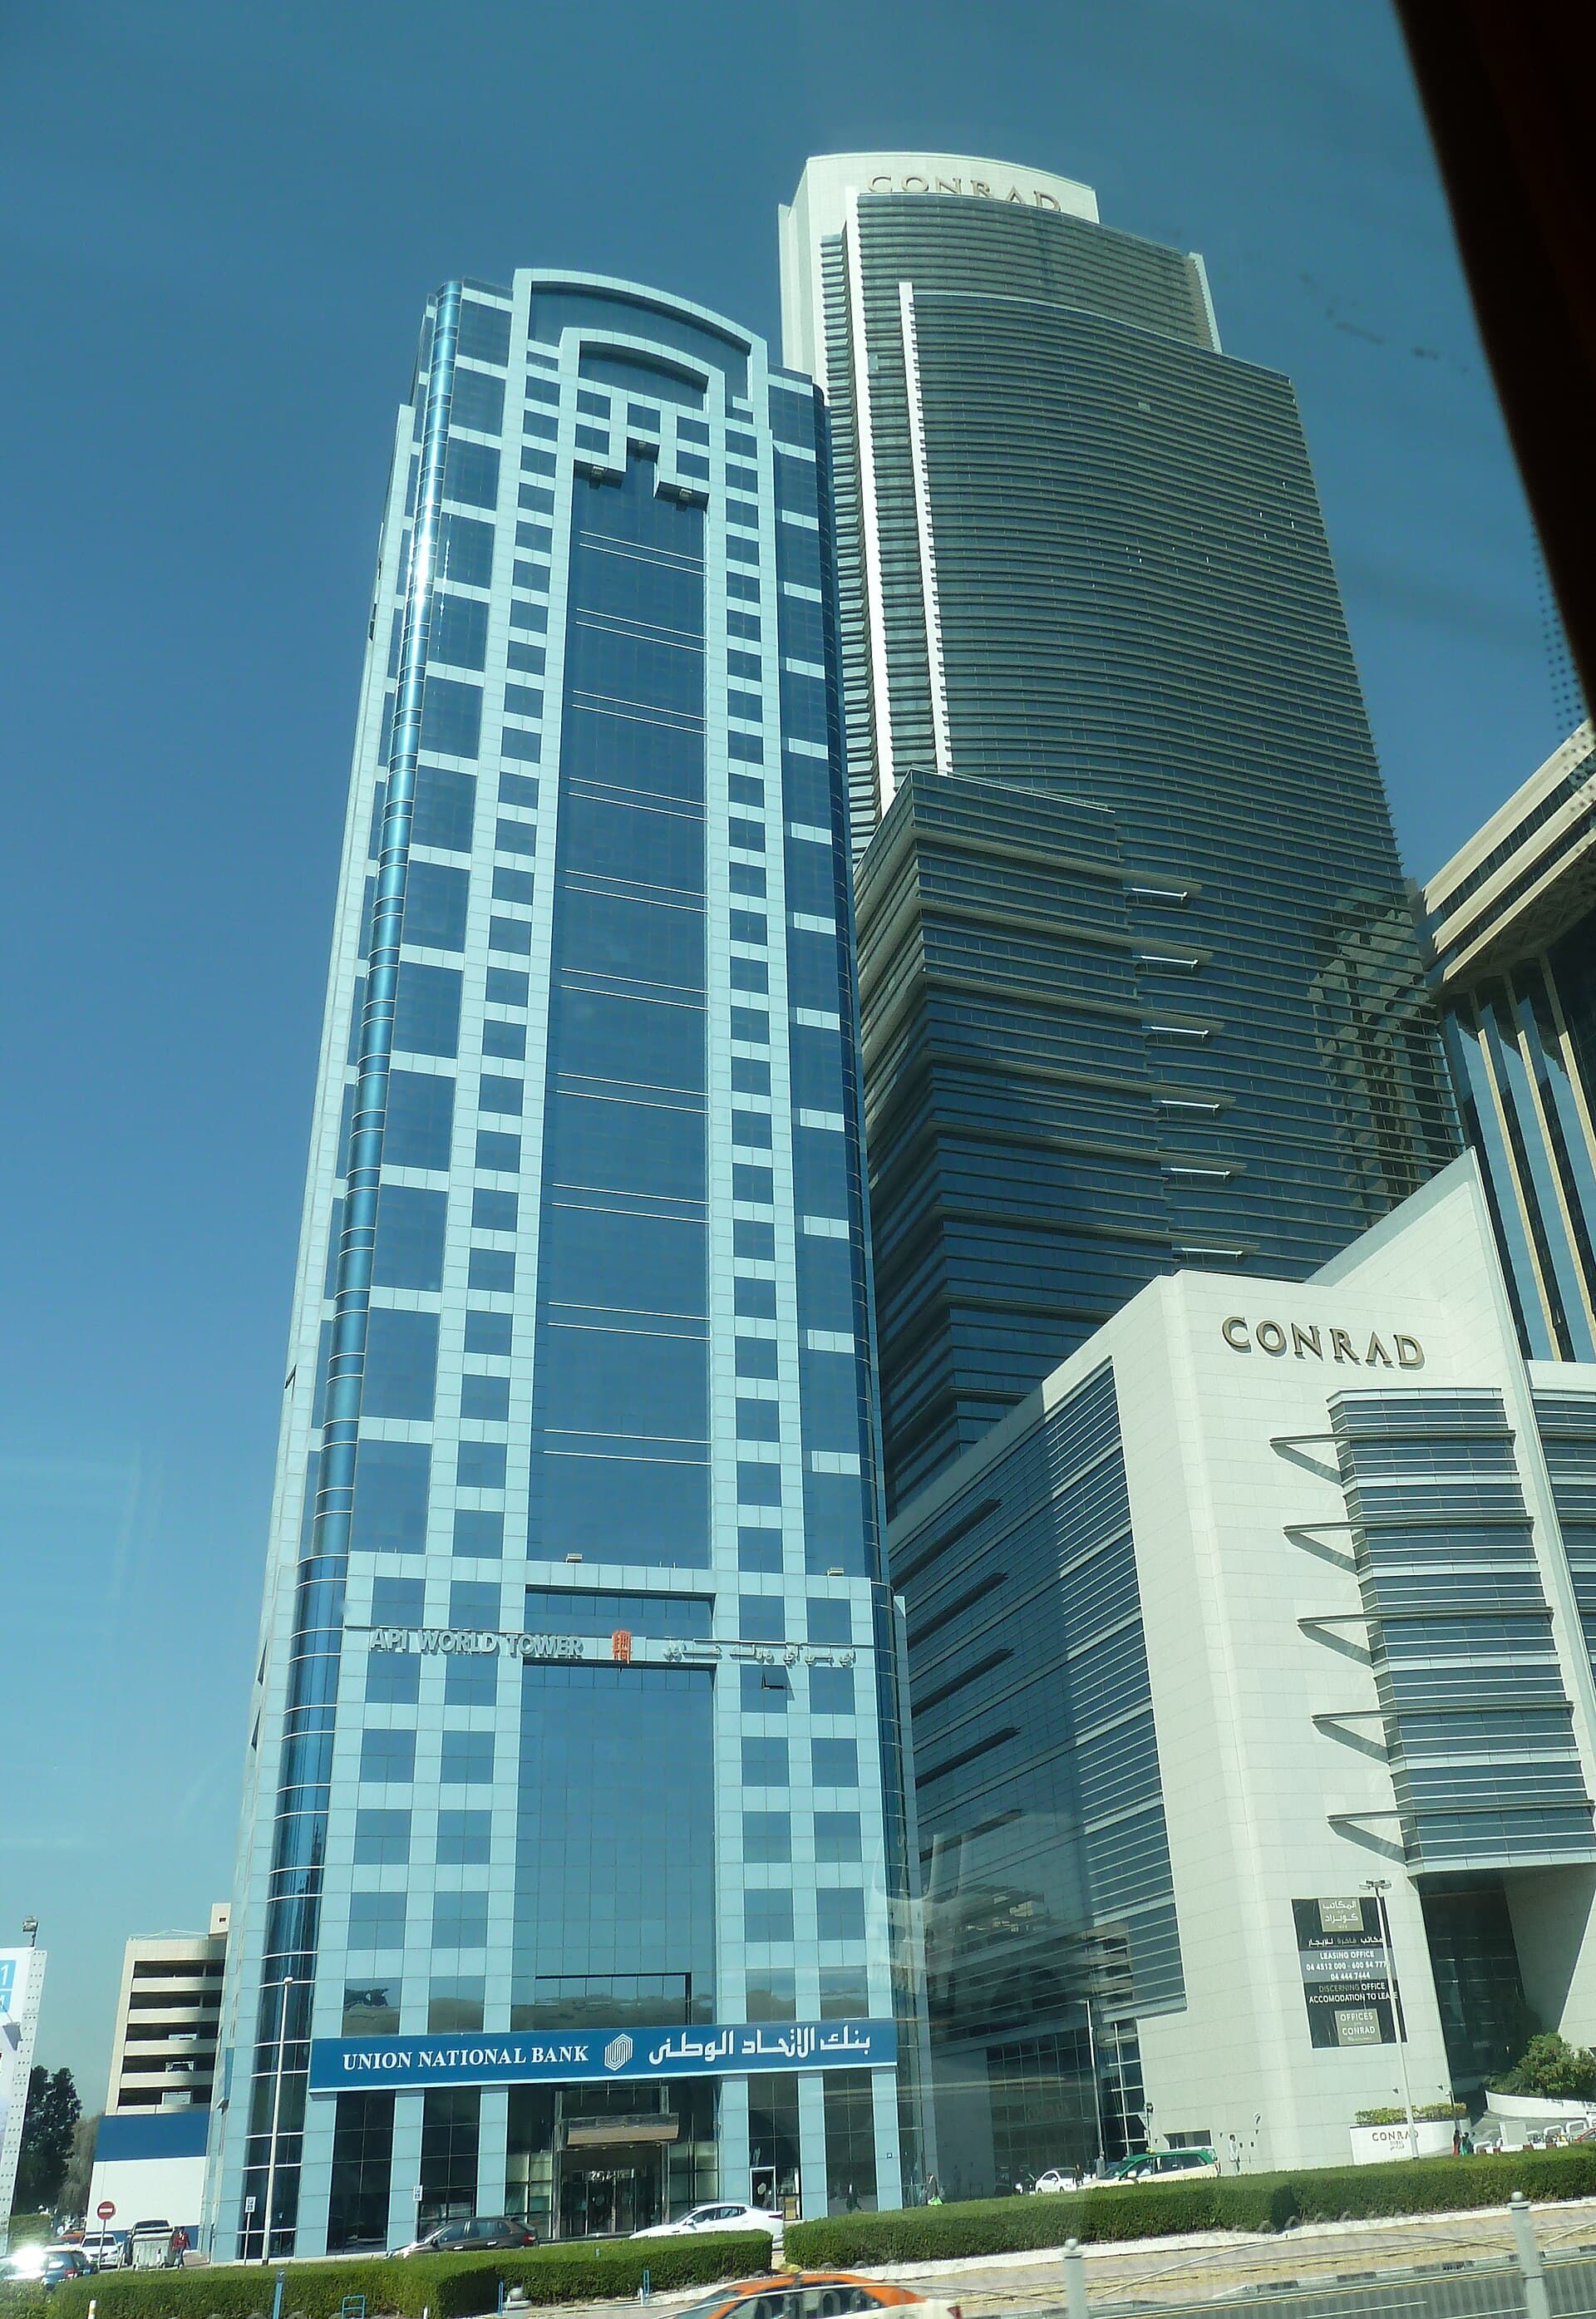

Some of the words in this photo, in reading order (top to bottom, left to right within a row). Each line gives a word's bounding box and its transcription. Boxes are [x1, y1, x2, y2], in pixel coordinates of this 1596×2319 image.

[867, 174, 1062, 212] CONRAD
[1221, 1316, 1425, 1368] CONRAD
[371, 1627, 408, 1651] API
[417, 1629, 499, 1654] WORLD
[505, 1632, 584, 1658] TOWER
[1320, 1952, 1349, 1960] LEASING
[1351, 1950, 1375, 1959] OFFICE
[1319, 1984, 1360, 1993] DISCERNING
[1361, 1982, 1386, 1991] OFFICE
[1309, 1994, 1365, 2004] ACCOMODATION
[1377, 1992, 1398, 2000] LEAE
[1340, 2012, 1373, 2021] OFFICES
[820, 2025, 871, 2056] بنك
[1342, 2026, 1376, 2036] CONRAD
[342, 2051, 413, 2071] UNION
[417, 2046, 527, 2068] NATIONAL
[531, 2045, 589, 2064] BANK
